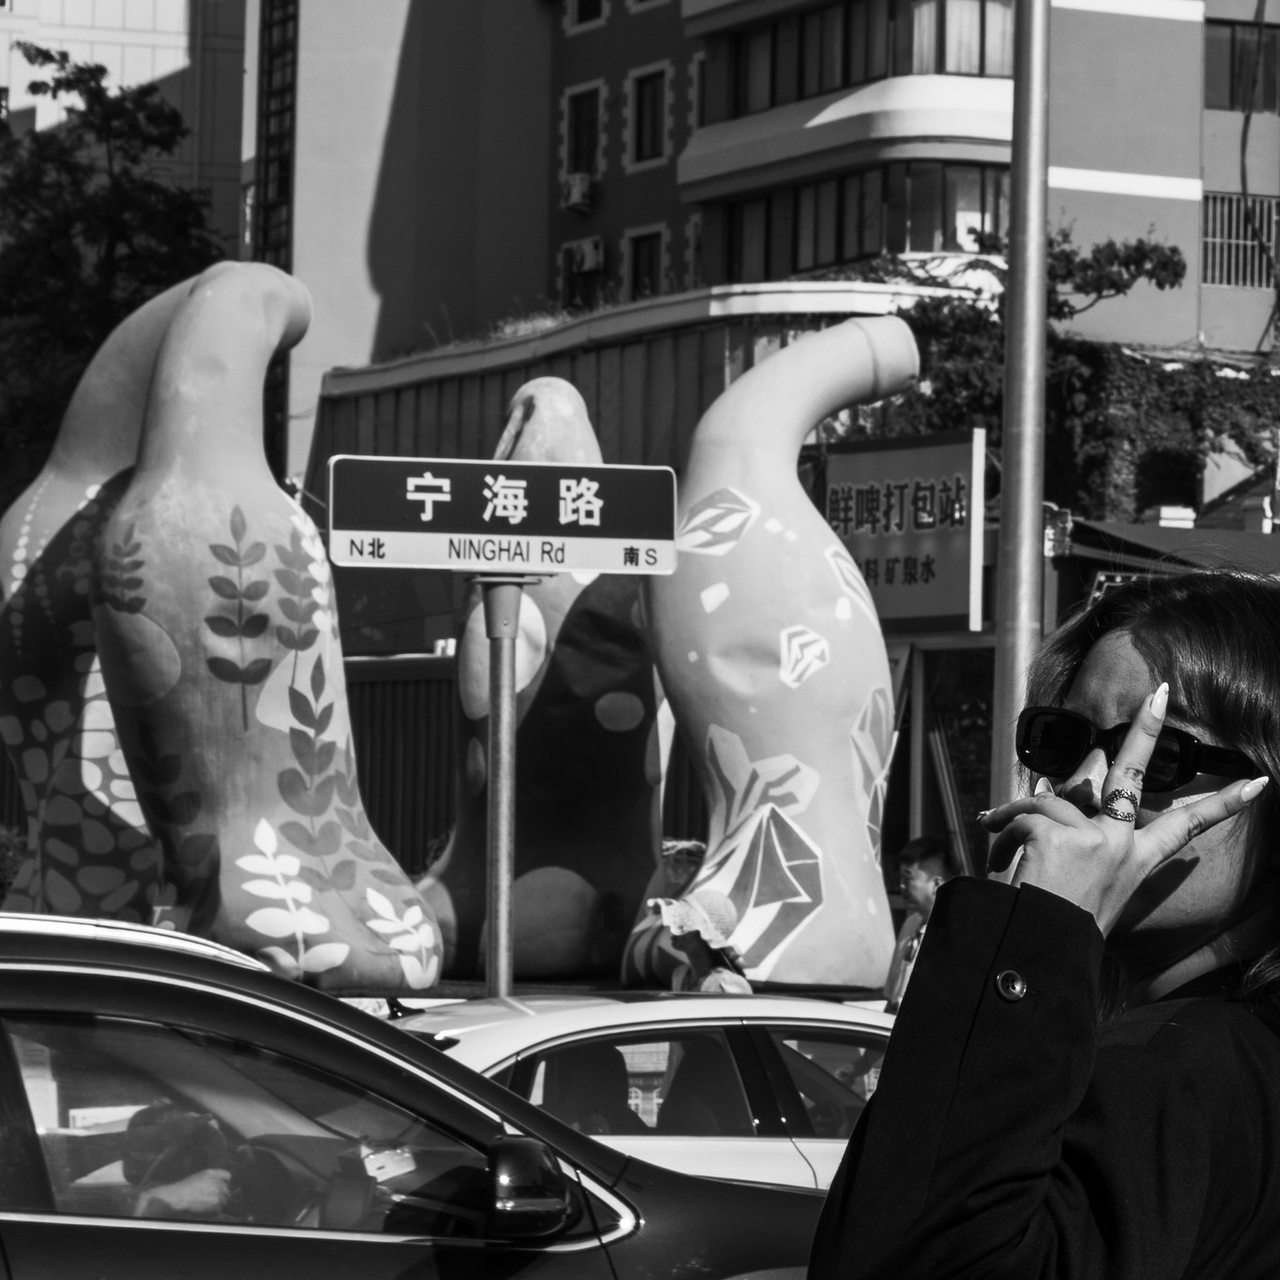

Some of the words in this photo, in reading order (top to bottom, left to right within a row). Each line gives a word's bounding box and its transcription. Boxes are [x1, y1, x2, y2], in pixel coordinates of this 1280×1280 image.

[406, 472, 604, 527] 宁海路
[828, 477, 967, 536] 鲜啤打包站
[448, 538, 530, 563] NINGHAI
[540, 540, 566, 564] Rd
